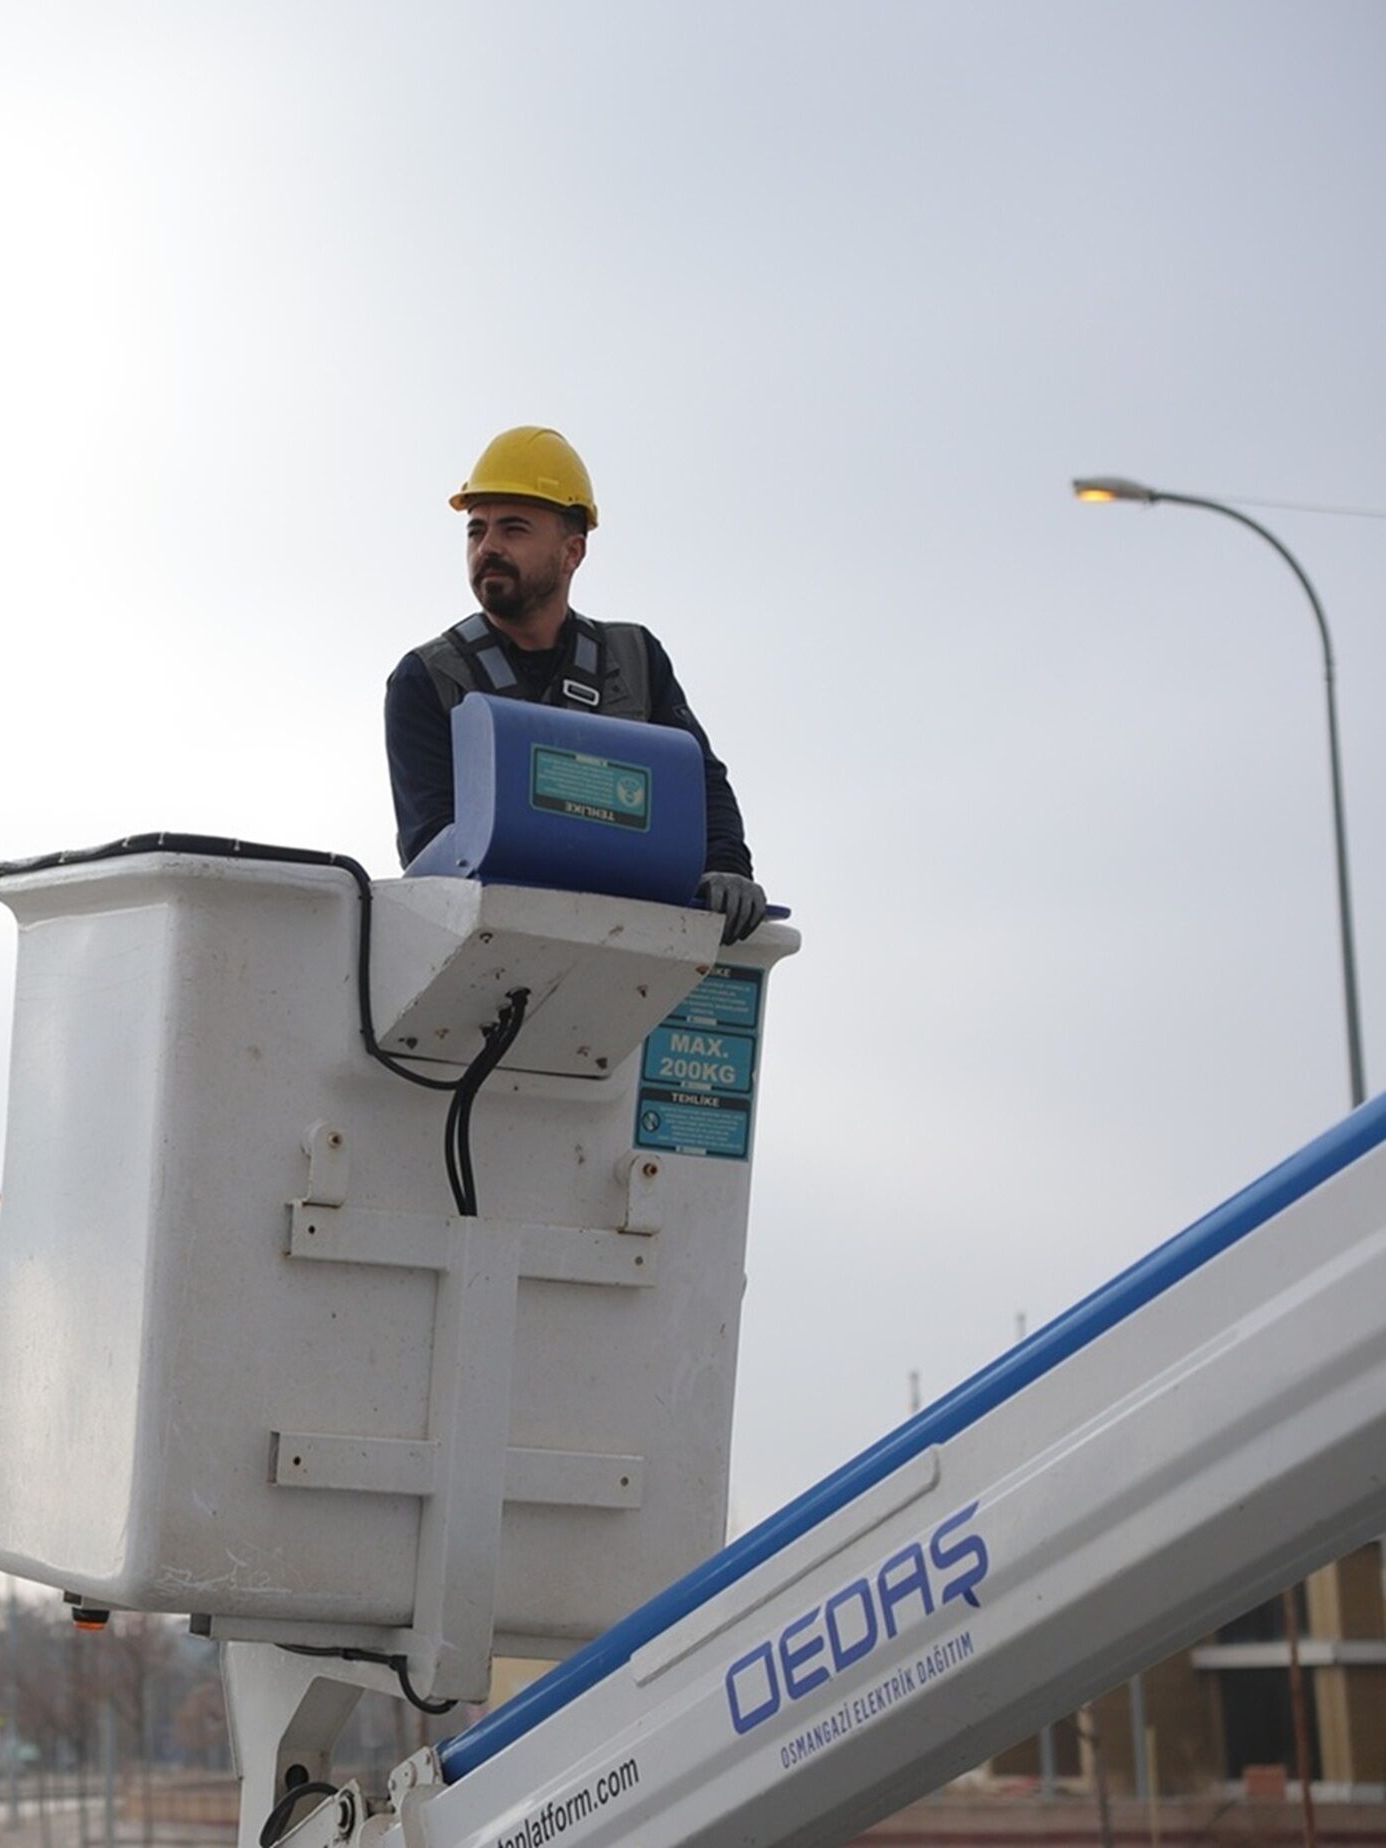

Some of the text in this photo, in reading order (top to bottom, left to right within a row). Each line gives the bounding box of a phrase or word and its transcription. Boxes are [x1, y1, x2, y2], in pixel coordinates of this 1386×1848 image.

[659, 1058, 736, 1084] 200KG
[670, 1033, 729, 1058] MAX.
[780, 1631, 975, 1770] OSMANGAZİ ELEKTRİK DAĞITIM
[497, 1758, 640, 1848] latform.com
